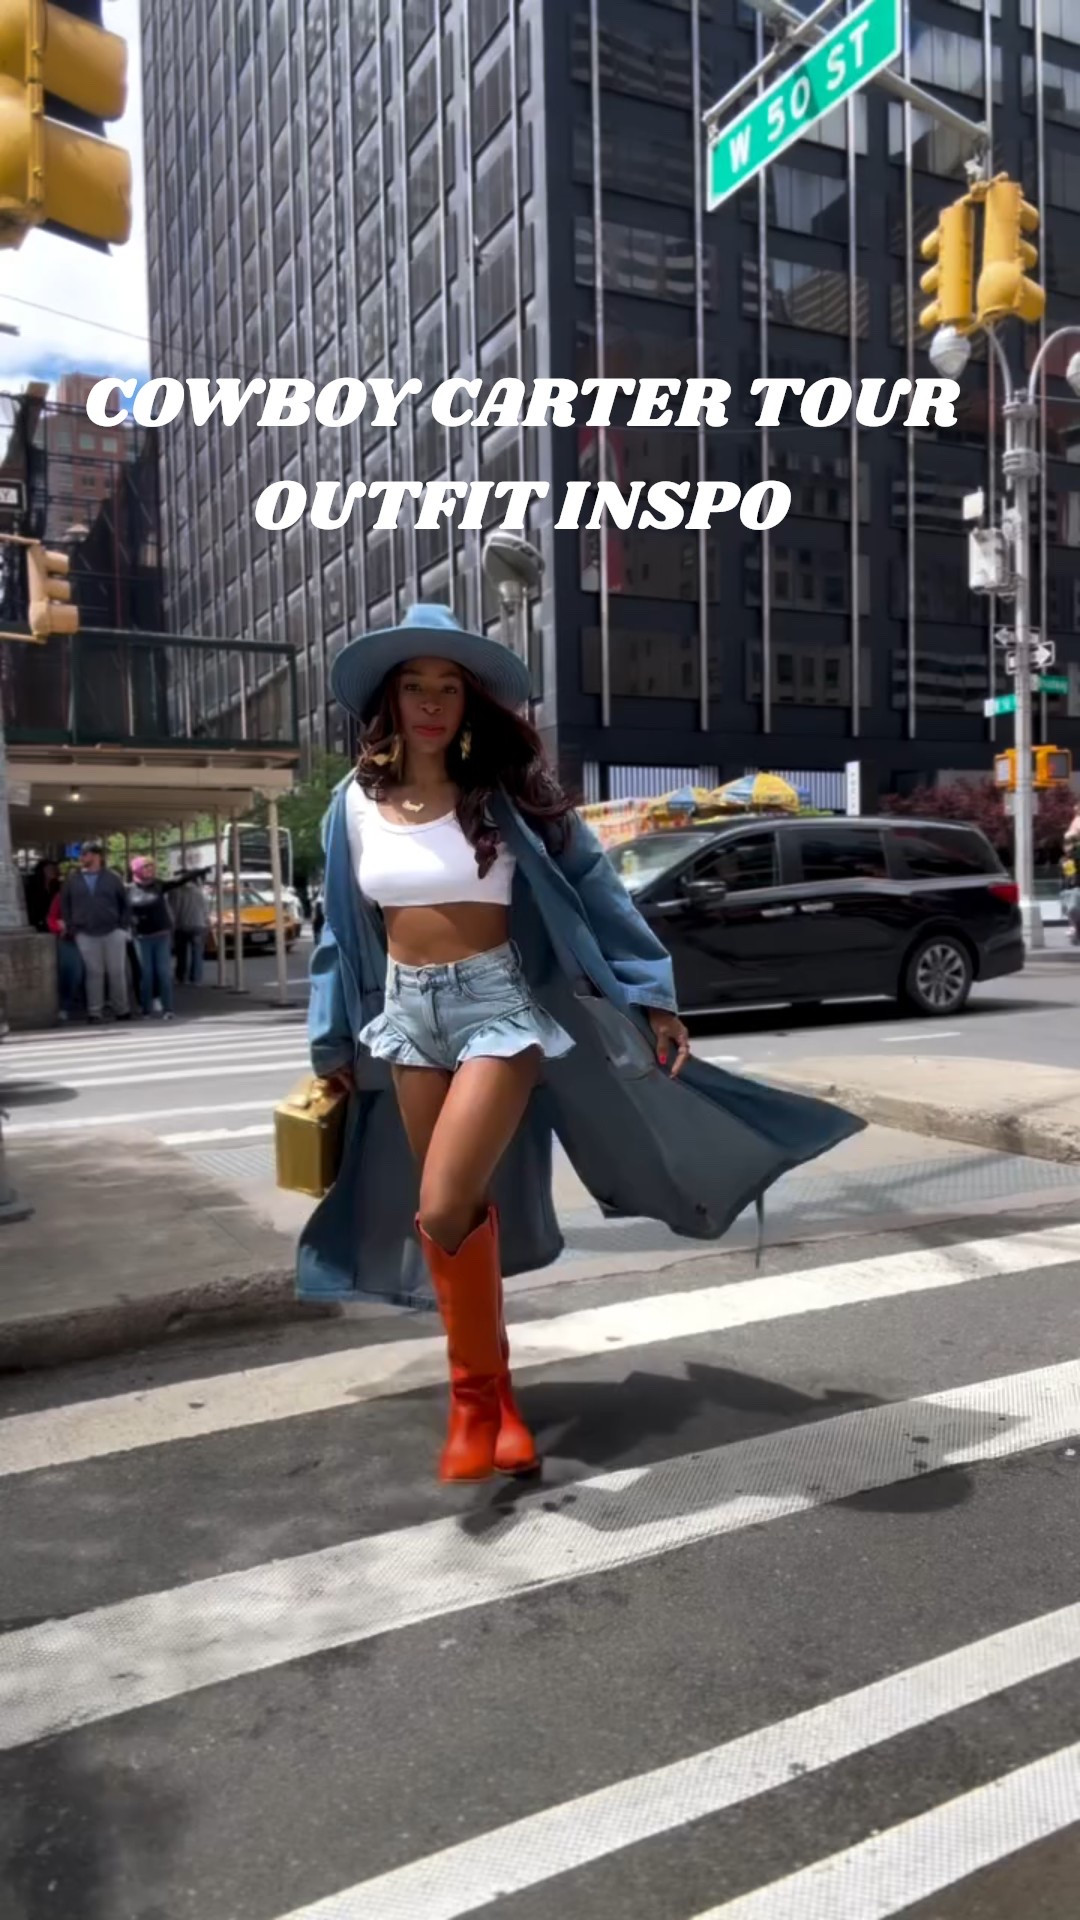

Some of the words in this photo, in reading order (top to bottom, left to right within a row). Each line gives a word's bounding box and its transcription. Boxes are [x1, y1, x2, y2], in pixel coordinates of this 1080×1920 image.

[728, 122, 751, 174] W
[767, 75, 810, 142] 50
[826, 19, 869, 91] ST
